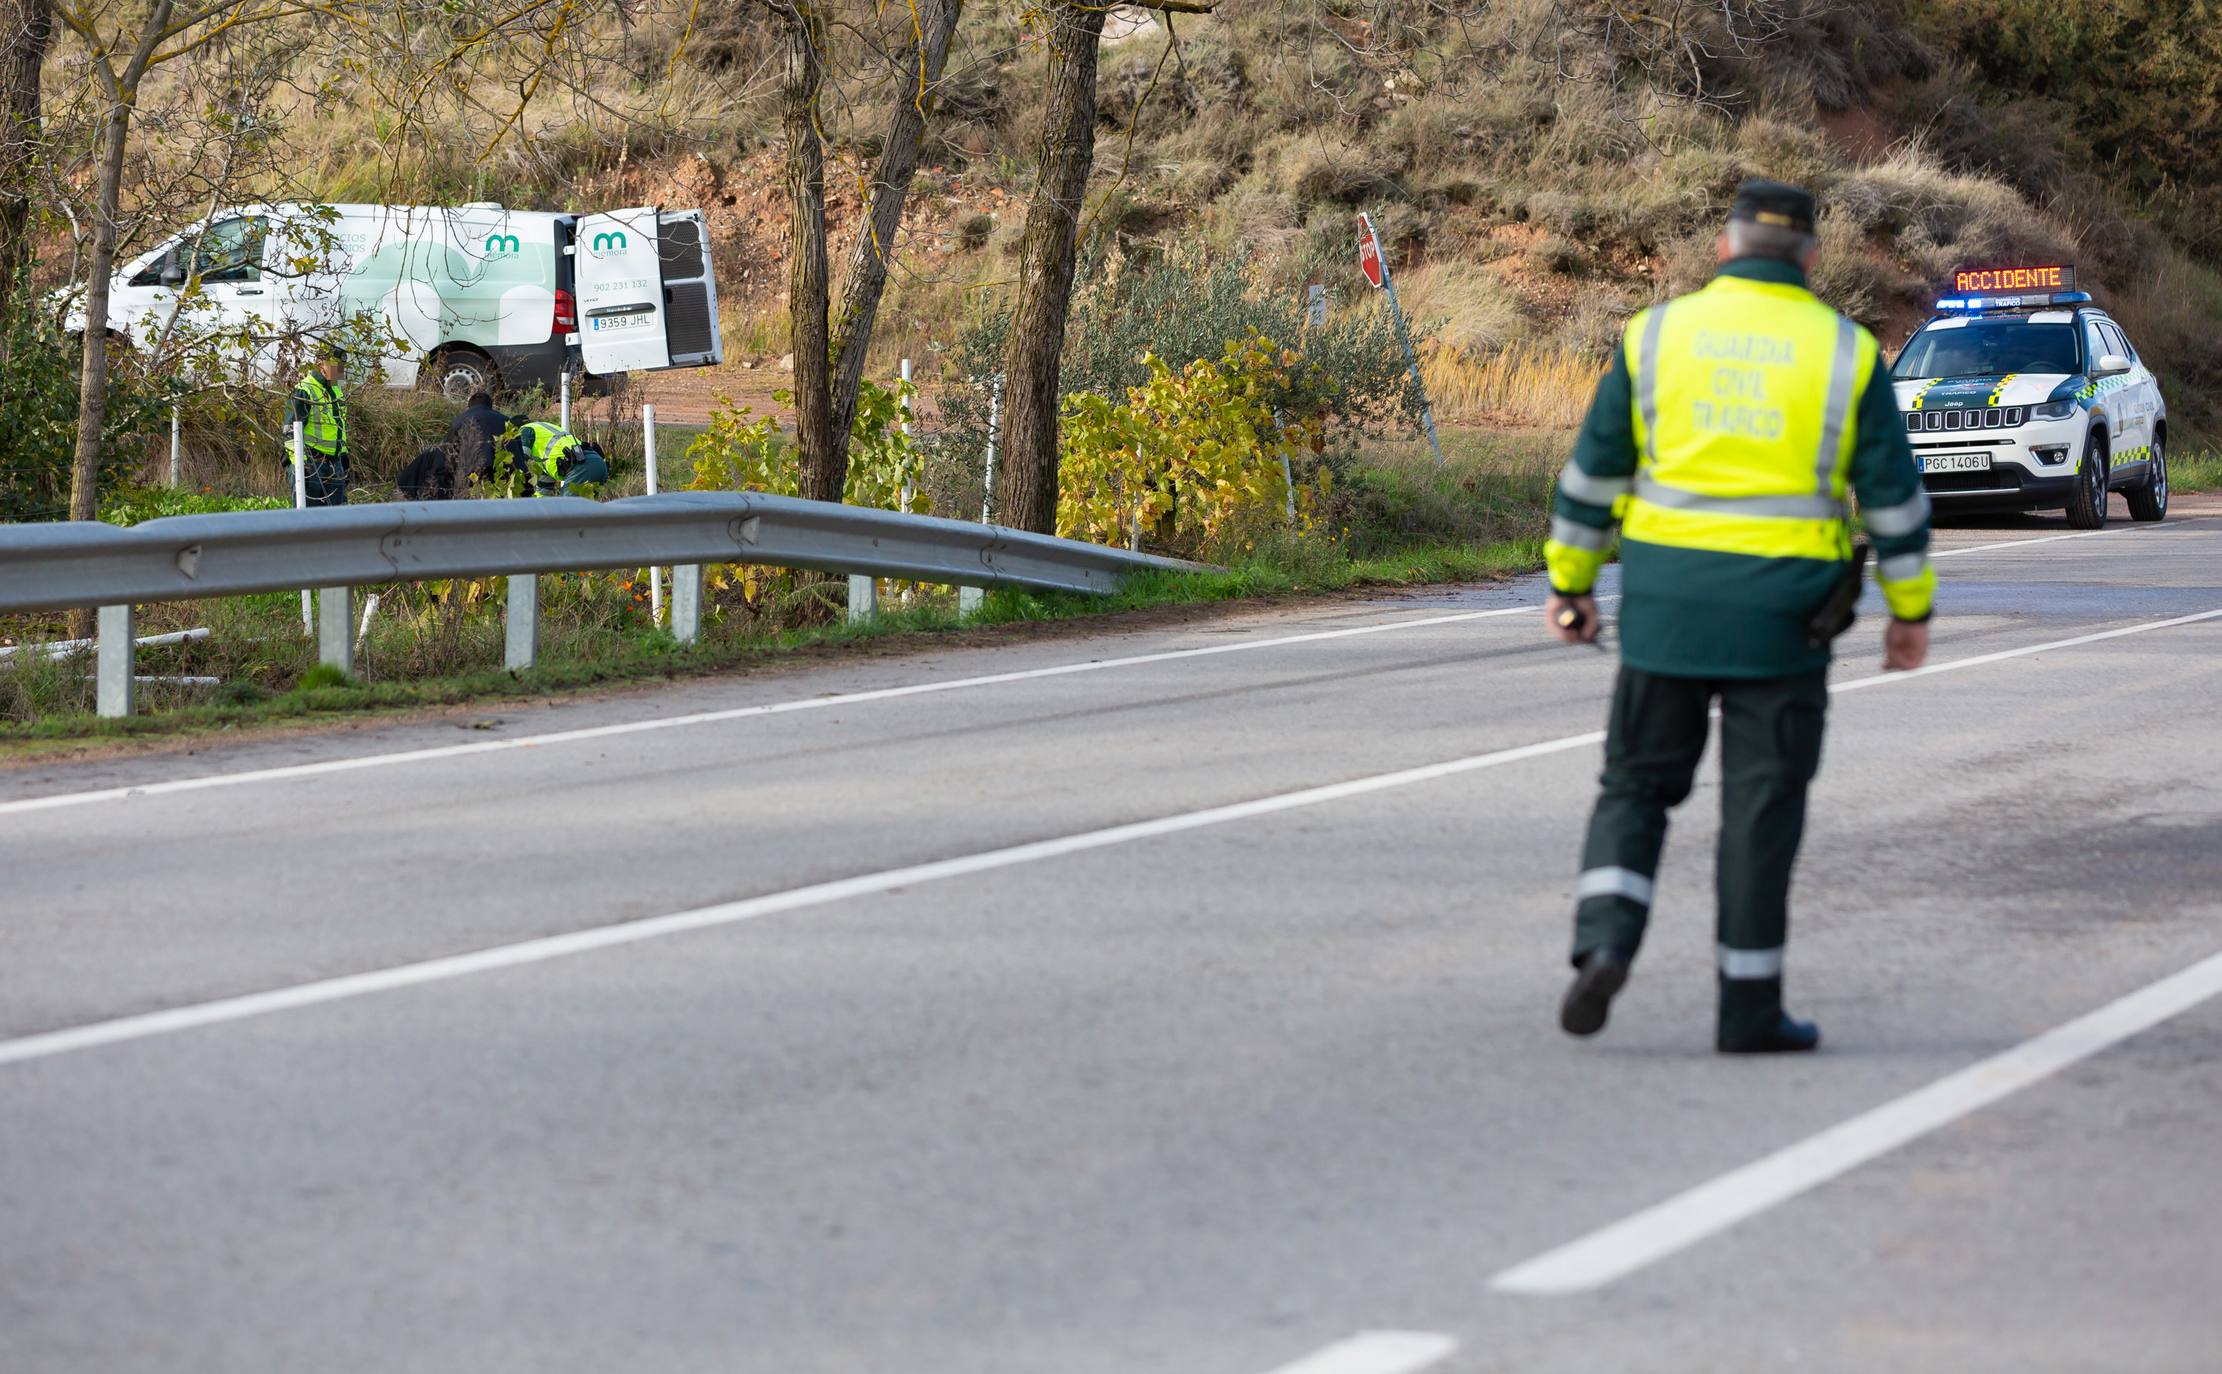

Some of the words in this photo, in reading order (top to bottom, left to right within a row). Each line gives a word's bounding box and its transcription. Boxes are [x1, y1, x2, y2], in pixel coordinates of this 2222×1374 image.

[594, 283, 610, 292] 902
[613, 281, 629, 290] 231
[632, 279, 648, 288] 132
[1956, 267, 2062, 291] ACCIDENTE
[600, 316, 627, 329] 9359
[630, 313, 650, 326] JHL
[1925, 457, 1948, 470] PGC
